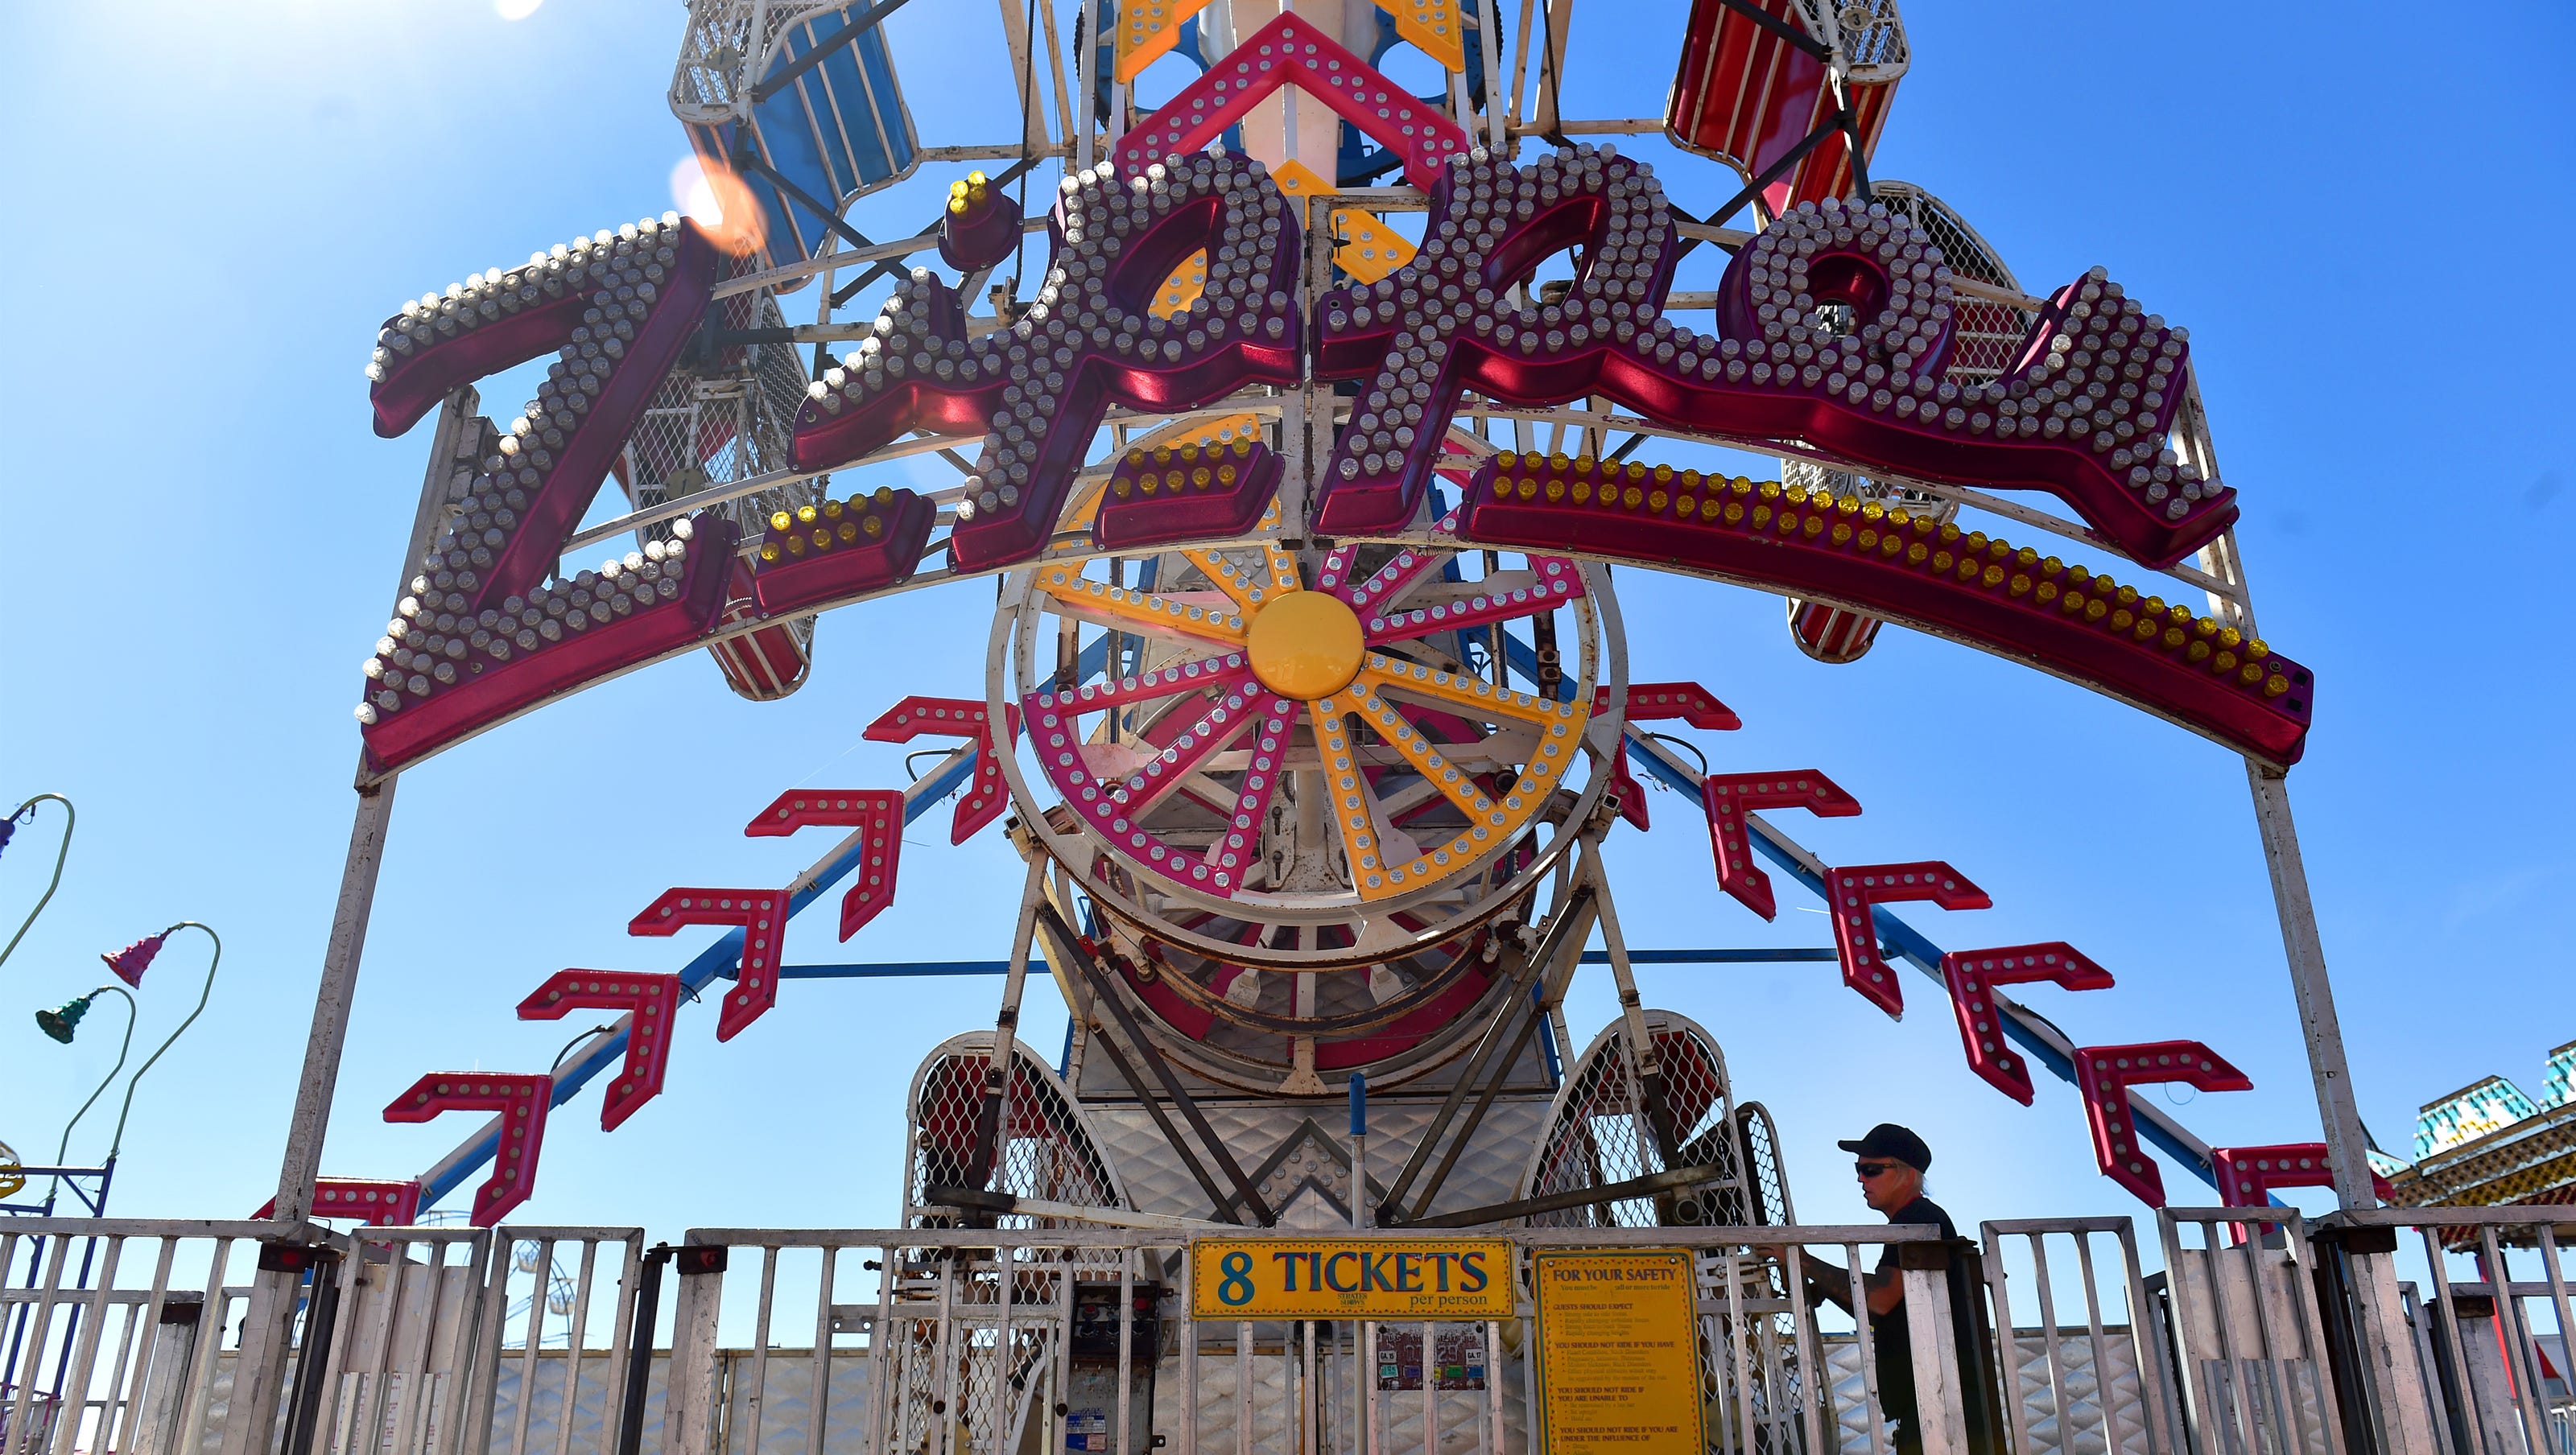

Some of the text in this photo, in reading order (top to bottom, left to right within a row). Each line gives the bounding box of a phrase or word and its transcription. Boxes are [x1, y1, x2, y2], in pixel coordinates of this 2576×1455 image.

[1853, 13, 1860, 26] 3
[357, 143, 2241, 773] Zipper
[1218, 1251, 1488, 1306] 8 TICKETS
[1553, 1267, 1677, 1281] FOR YOUR SAFETY
[1410, 1294, 1488, 1309] per person
